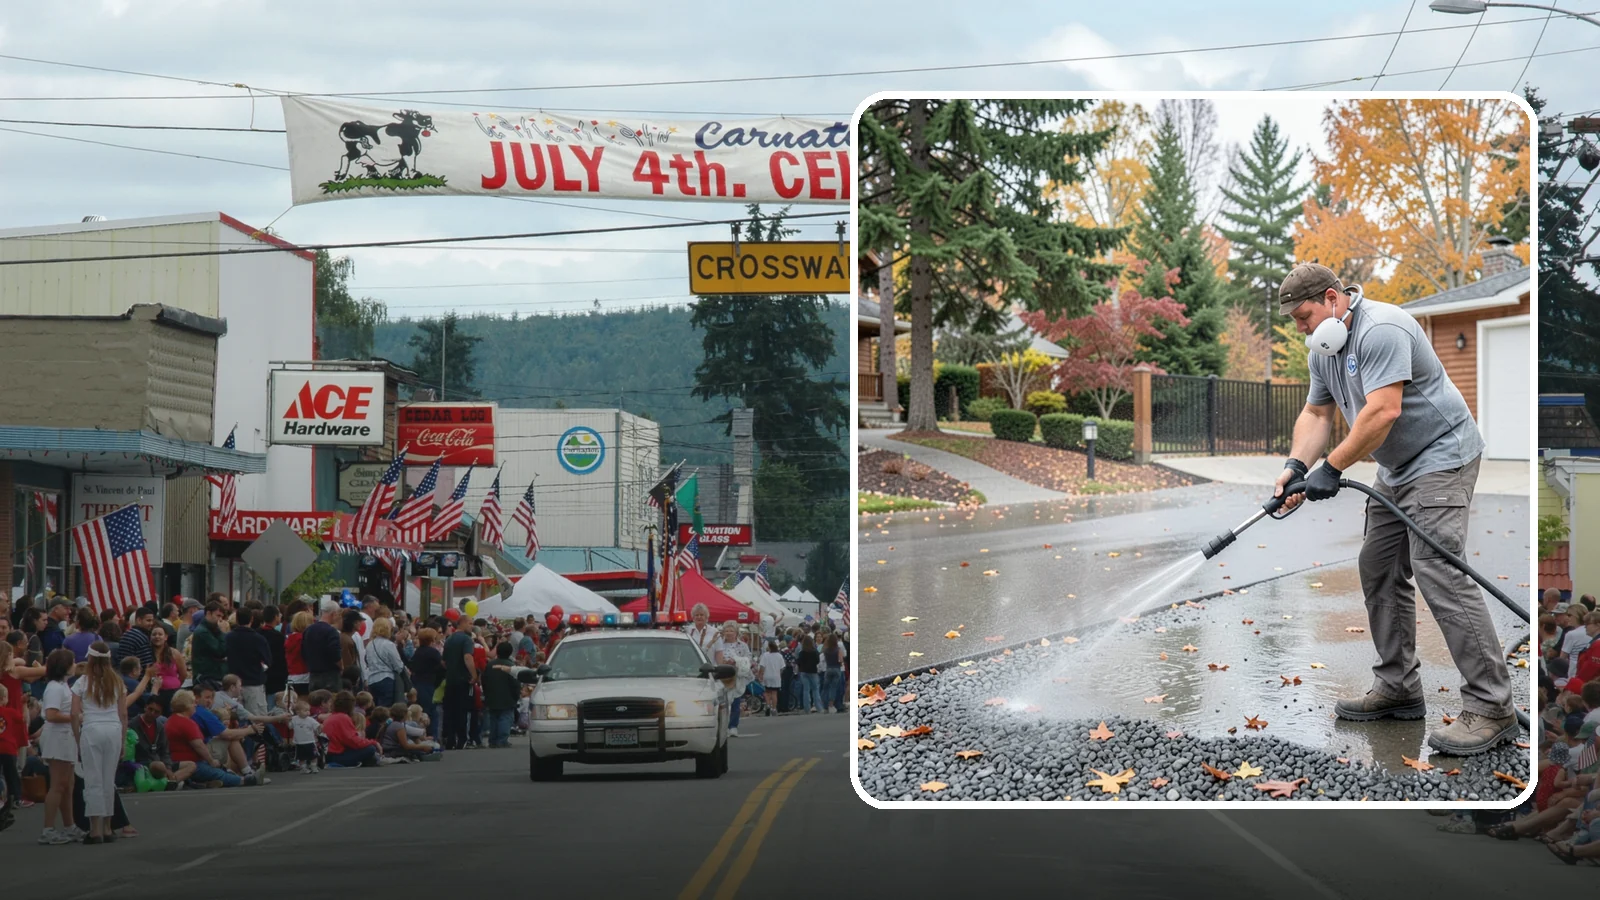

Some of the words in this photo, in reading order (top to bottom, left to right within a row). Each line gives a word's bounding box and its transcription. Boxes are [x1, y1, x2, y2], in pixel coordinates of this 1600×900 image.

[694, 121, 850, 150] Carnat
[481, 141, 605, 192] JULY
[632, 149, 746, 198] 4th.
[697, 254, 850, 280] CROSSWA
[282, 380, 373, 420] ACE
[405, 409, 452, 422] CEDAR
[461, 409, 485, 422] LOG
[283, 421, 371, 436] Hardware
[353, 467, 386, 480] Simpl
[95, 485, 124, 495] Vincent
[126, 486, 136, 495] de
[137, 486, 155, 495] Paul
[688, 527, 741, 535] CRNATION
[699, 535, 730, 543] GLASS
